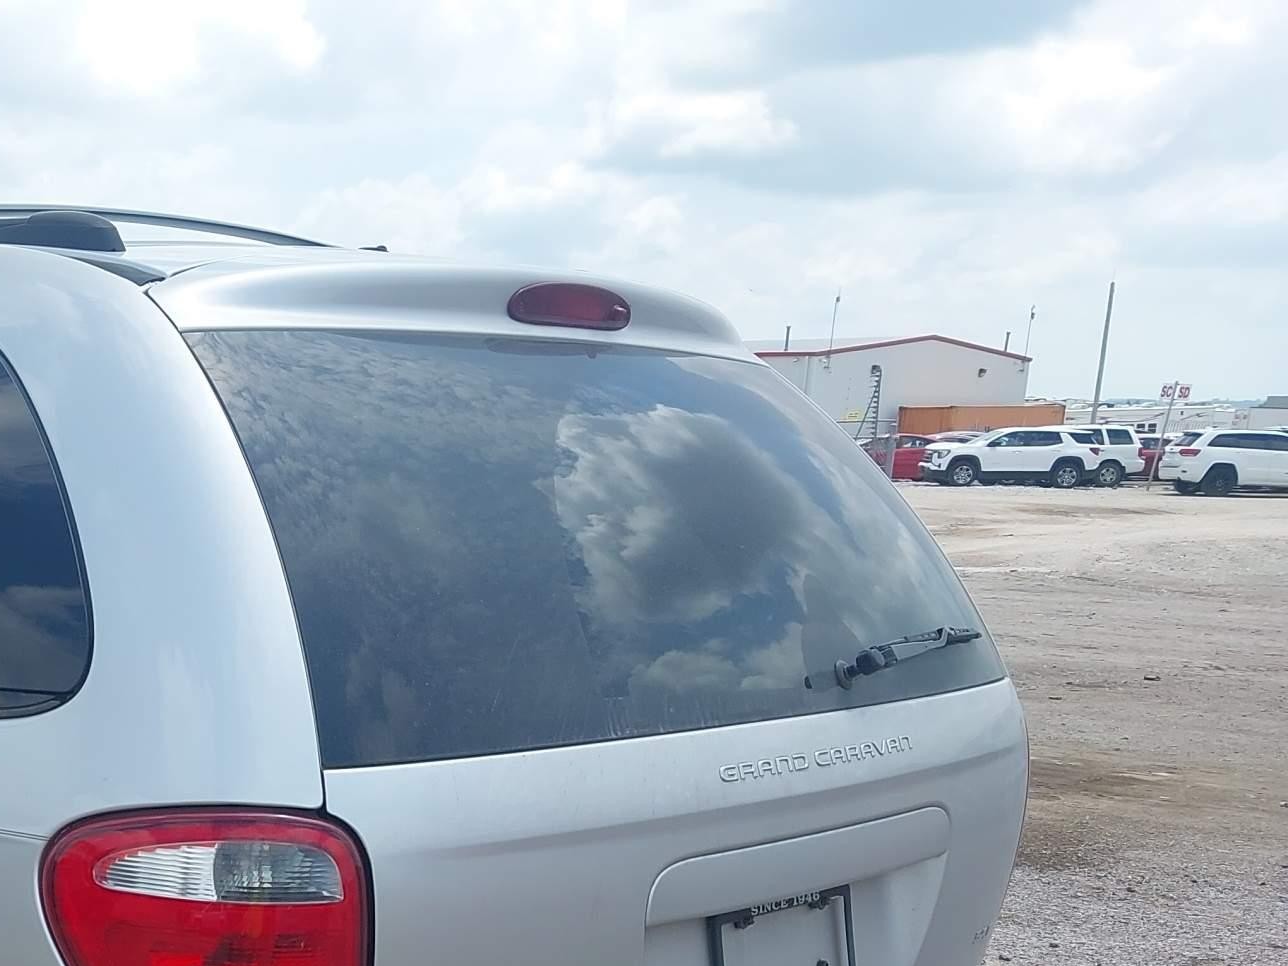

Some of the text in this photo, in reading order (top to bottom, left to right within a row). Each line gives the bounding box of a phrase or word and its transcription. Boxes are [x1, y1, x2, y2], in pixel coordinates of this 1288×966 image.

[1160, 385, 1173, 398] SC
[1178, 386, 1191, 399] SD
[718, 734, 913, 783] GRAND CARAVAN
[751, 899, 789, 916] SINCE
